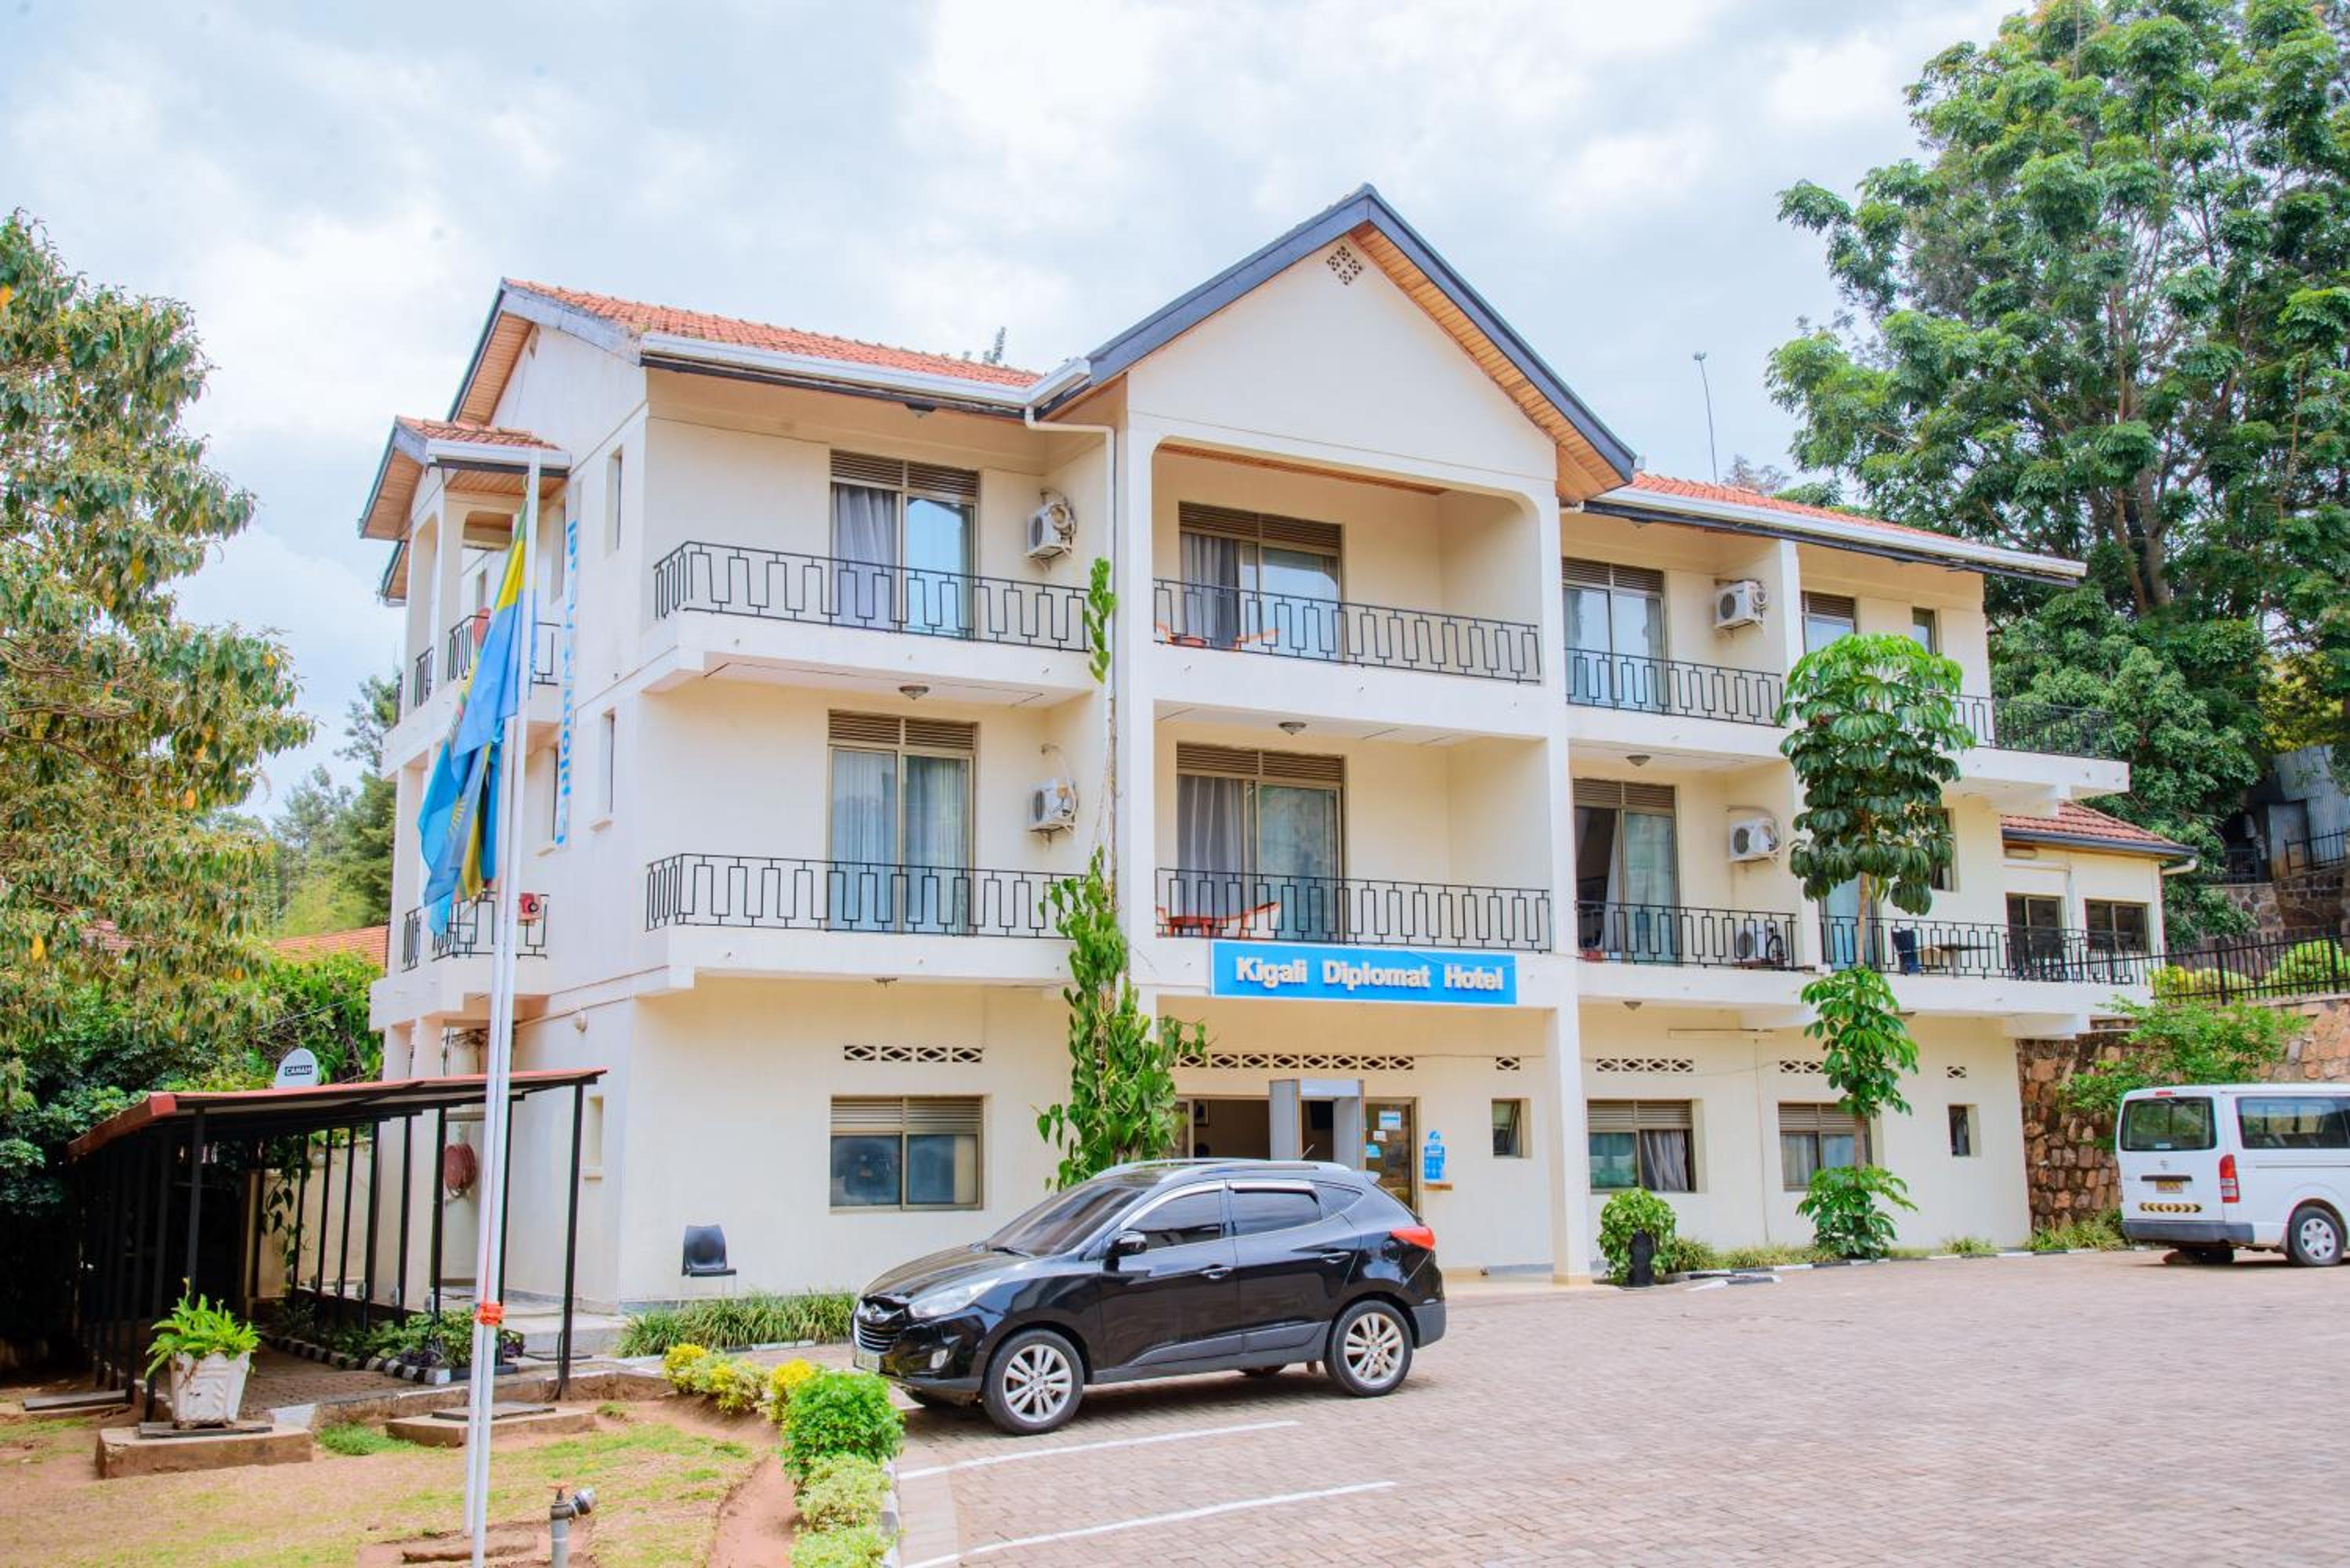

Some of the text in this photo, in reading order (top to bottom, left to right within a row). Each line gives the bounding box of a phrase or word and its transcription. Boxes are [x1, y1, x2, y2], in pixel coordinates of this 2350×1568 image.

[1235, 956, 1504, 991] Kigali Diplomat Hotel
